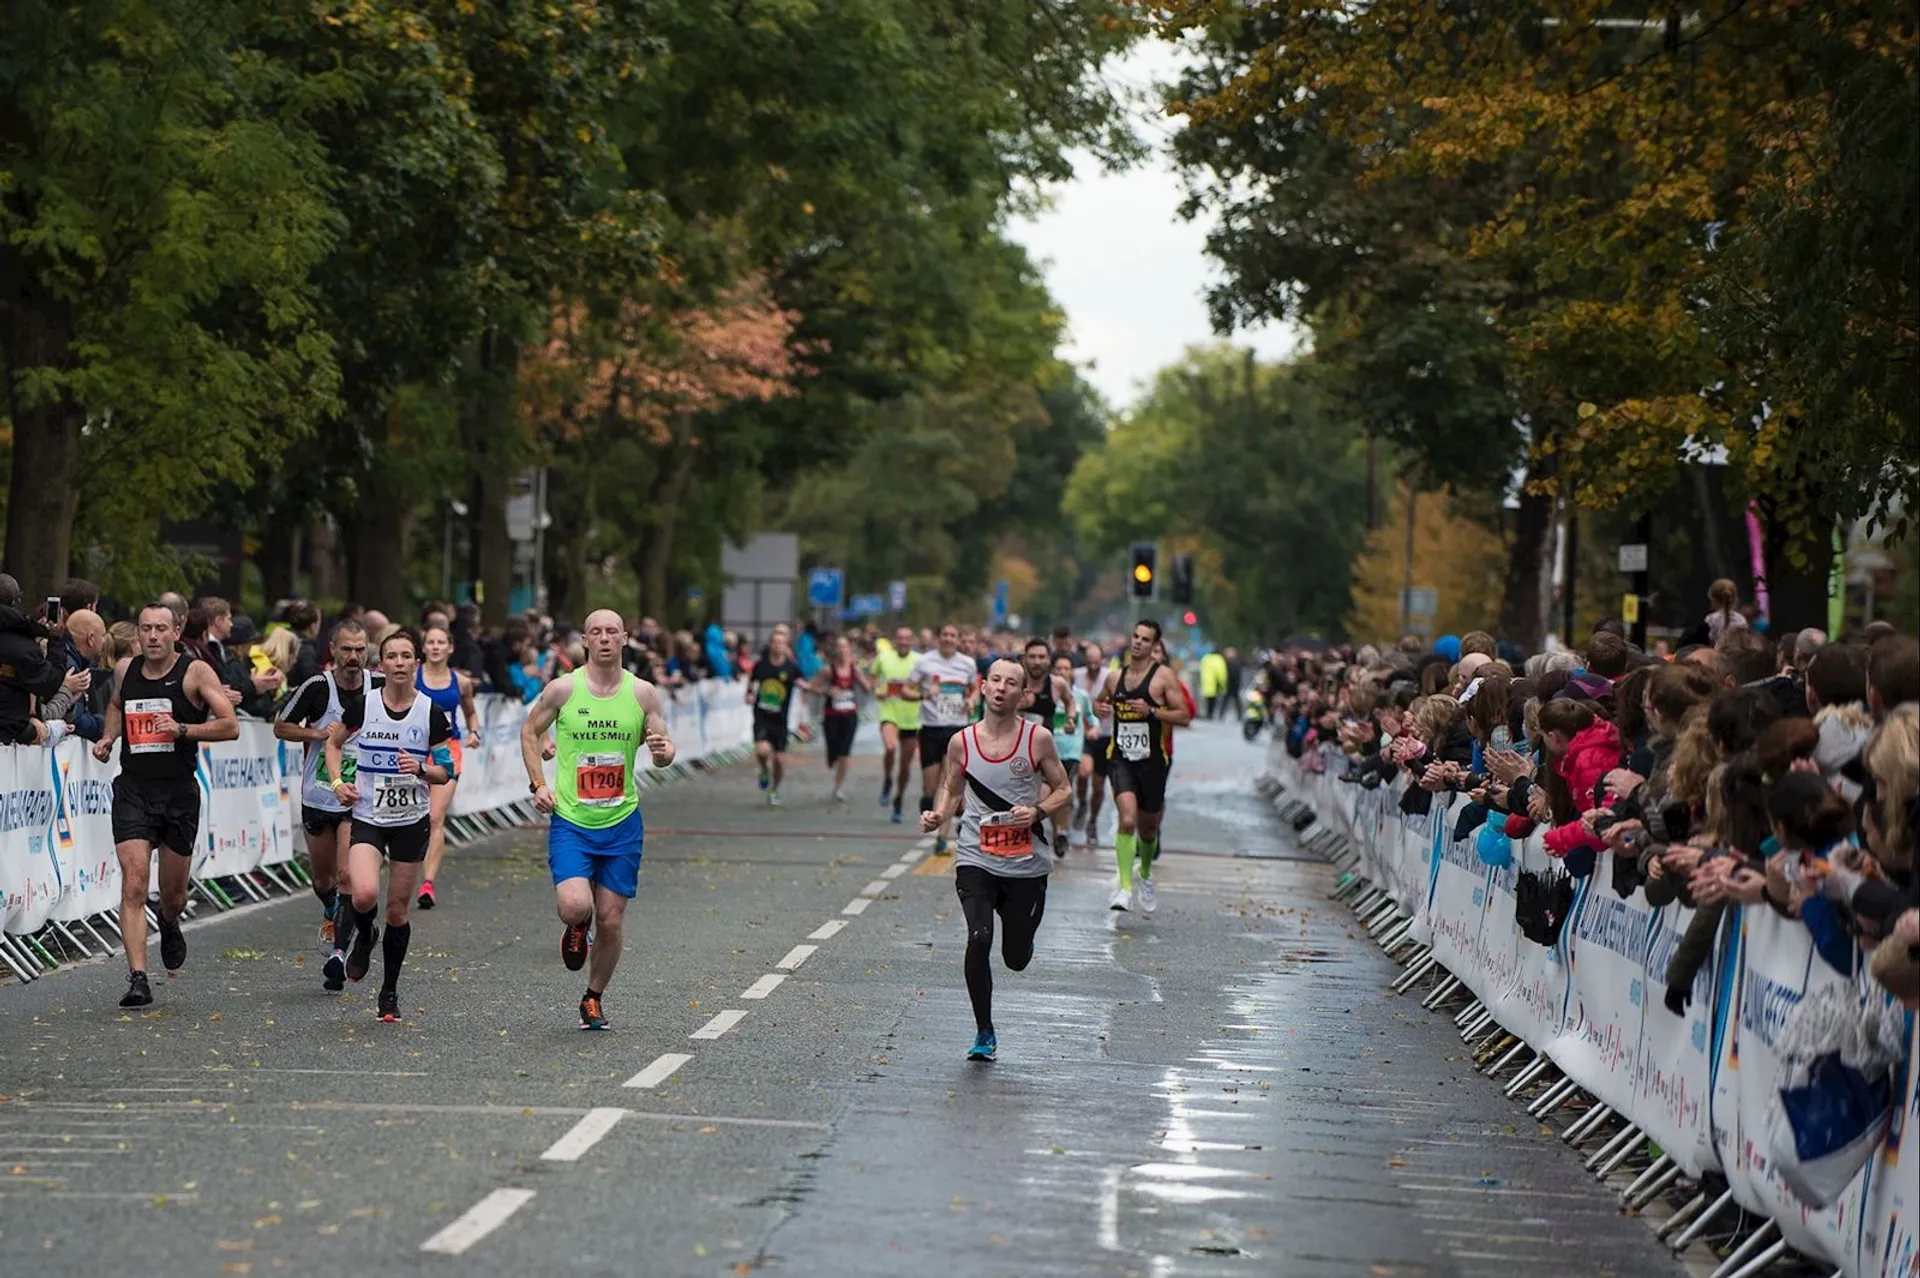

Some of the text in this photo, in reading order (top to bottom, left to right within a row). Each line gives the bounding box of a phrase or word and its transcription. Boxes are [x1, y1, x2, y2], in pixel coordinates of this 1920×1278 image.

[588, 720, 619, 729] MAKE
[366, 731, 399, 741] SARAH
[573, 732, 632, 741] KYLE SMILE
[371, 753, 382, 766] C
[387, 754, 398, 767] &
[580, 771, 623, 790] 11206
[375, 788, 417, 807] 7881
